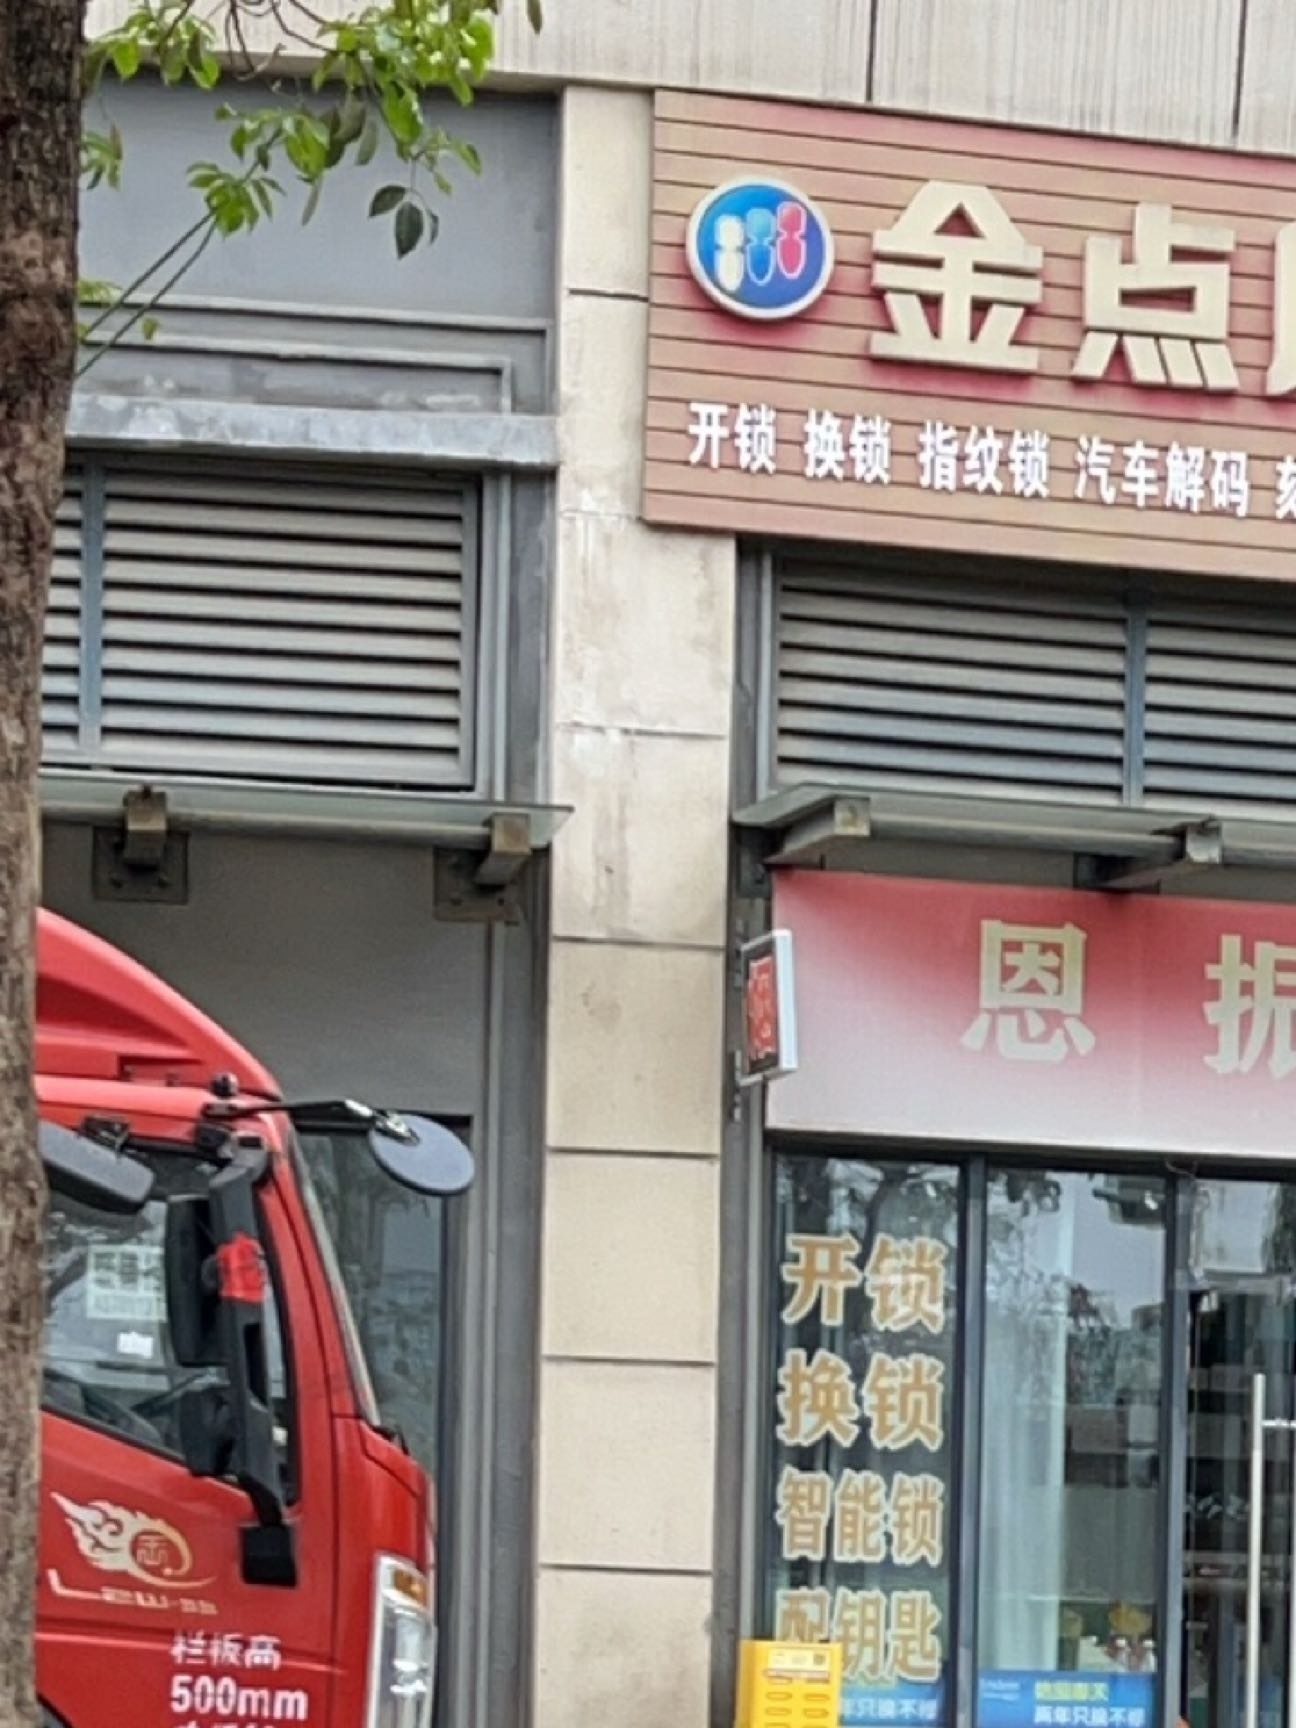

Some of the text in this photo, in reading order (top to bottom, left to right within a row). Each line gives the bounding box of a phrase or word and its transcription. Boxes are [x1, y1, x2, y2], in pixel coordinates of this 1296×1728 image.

[687, 401, 778, 475] 开锁
[803, 407, 892, 486] 换锁
[918, 419, 1051, 500] 指纹锁
[1073, 434, 1250, 518] 汽车解码
[781, 1233, 948, 1334] 开锁
[776, 1348, 945, 1453] 换锁
[775, 1465, 945, 1567] 智能锁
[170, 1675, 309, 1720] 500mm
